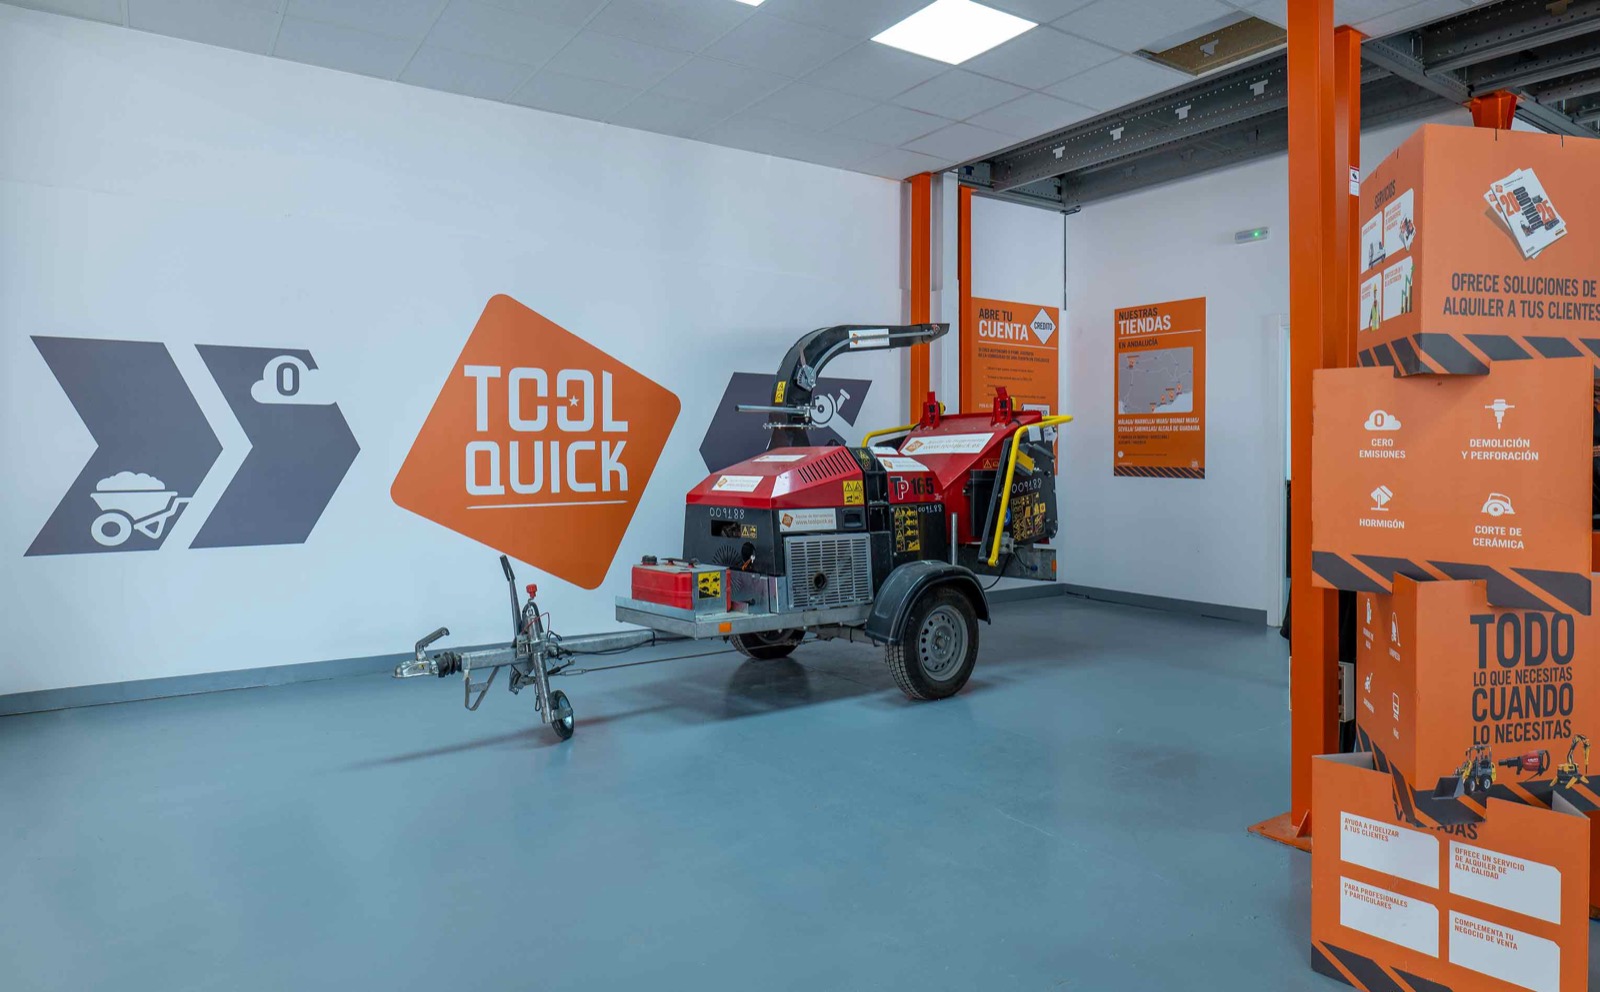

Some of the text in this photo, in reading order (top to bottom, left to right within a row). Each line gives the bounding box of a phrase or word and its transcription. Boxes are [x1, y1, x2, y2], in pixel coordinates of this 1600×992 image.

[1500, 192, 1520, 216] 20
[1452, 272, 1597, 298] OFRECE SOLUCIONES DE
[979, 308, 1012, 322] ABRE TU
[1118, 308, 1158, 320] NUESTRAS
[1443, 297, 1600, 321] ALQUILER A TUS CLIENTES
[978, 320, 1028, 341] CUENTA
[1118, 314, 1172, 334] TIENDAS
[1371, 438, 1394, 447] CERO
[1470, 437, 1530, 448] DEMOLICIÓN
[1359, 450, 1406, 459] EMISIONES
[1462, 450, 1539, 461] Y PERFORACIÓN
[464, 440, 629, 496] QUICK
[910, 478, 934, 495] 165
[710, 506, 745, 520] 009188
[1359, 518, 1405, 529] HORMIGÓN
[1474, 525, 1522, 536] CORTE DE
[1472, 536, 1524, 549] CERÁMICA
[1470, 612, 1575, 669] TODO
[1473, 666, 1572, 687] LO QUE NECESITAS
[1472, 683, 1574, 722] CUANDO
[1473, 719, 1572, 745] LO NECESITAS
[1344, 818, 1362, 828] AYUDA
[1369, 824, 1399, 837] FIDELIZAR
[1362, 829, 1388, 842] CLIENTES
[1455, 847, 1480, 860] OFRECE
[1493, 857, 1525, 871] SERVICIO
[1465, 858, 1496, 872] ALQUILER
[1498, 866, 1507, 874] DE
[1455, 862, 1499, 879] ALTA CALIDAD
[1344, 882, 1408, 907] PARA PROFESIONALES
[1350, 891, 1392, 909] PARTICULARES
[1455, 917, 1503, 938] COMPLEMENTA
[1455, 925, 1484, 939] NEGOCIO
[1496, 938, 1518, 950] VENTA
